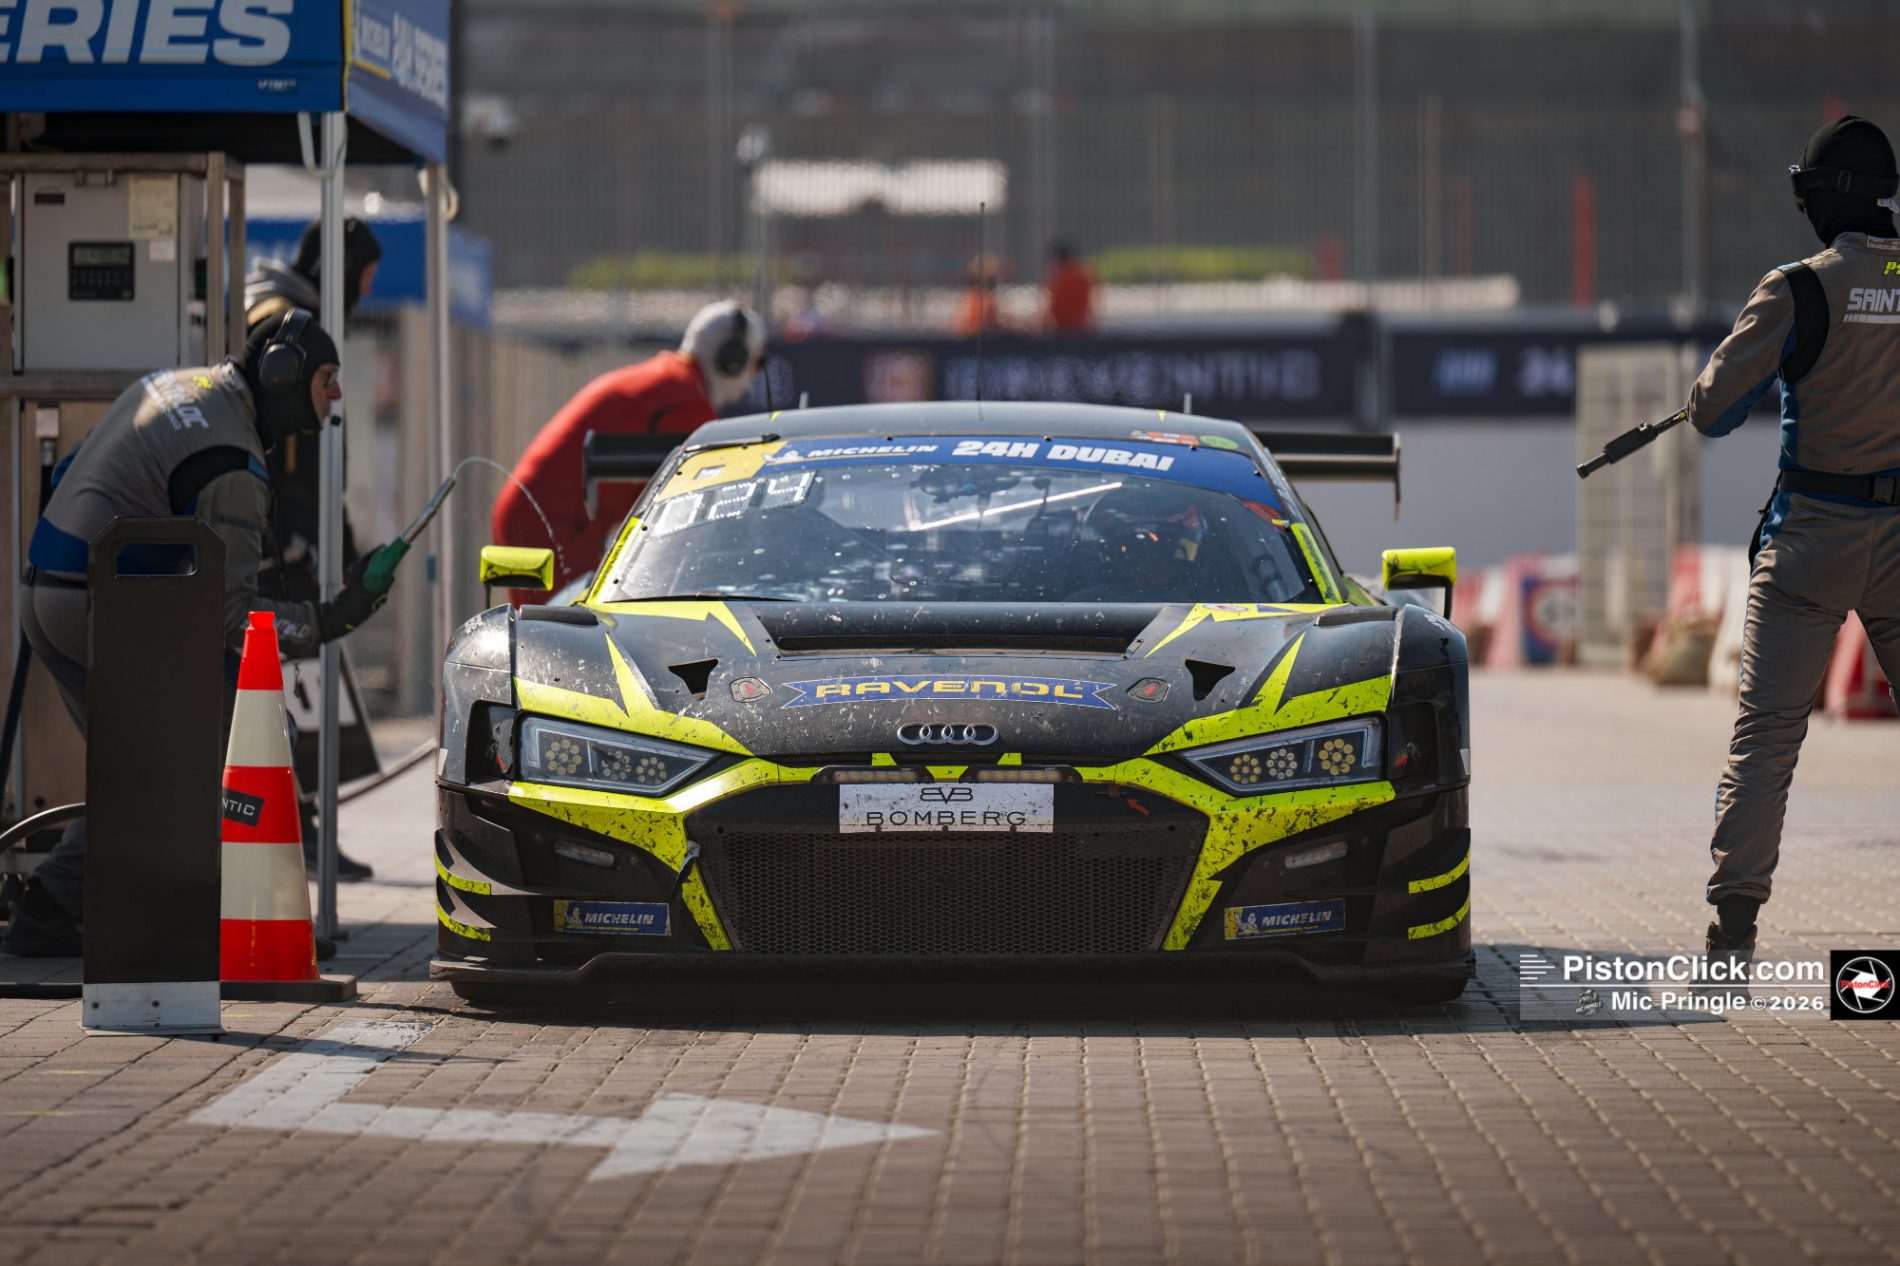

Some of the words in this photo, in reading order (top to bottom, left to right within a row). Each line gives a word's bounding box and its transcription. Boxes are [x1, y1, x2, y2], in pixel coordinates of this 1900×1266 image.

[0, 0, 293, 66] RIES
[807, 445, 938, 457] MICHELIN
[952, 440, 1040, 458] 24H
[1046, 444, 1175, 471] DUBAI
[652, 471, 814, 537] 024
[815, 680, 1084, 698] RAVENOL
[866, 811, 1026, 826] BOMBERG
[584, 912, 655, 925] MICHELIN
[1262, 910, 1332, 927] MICHELIN
